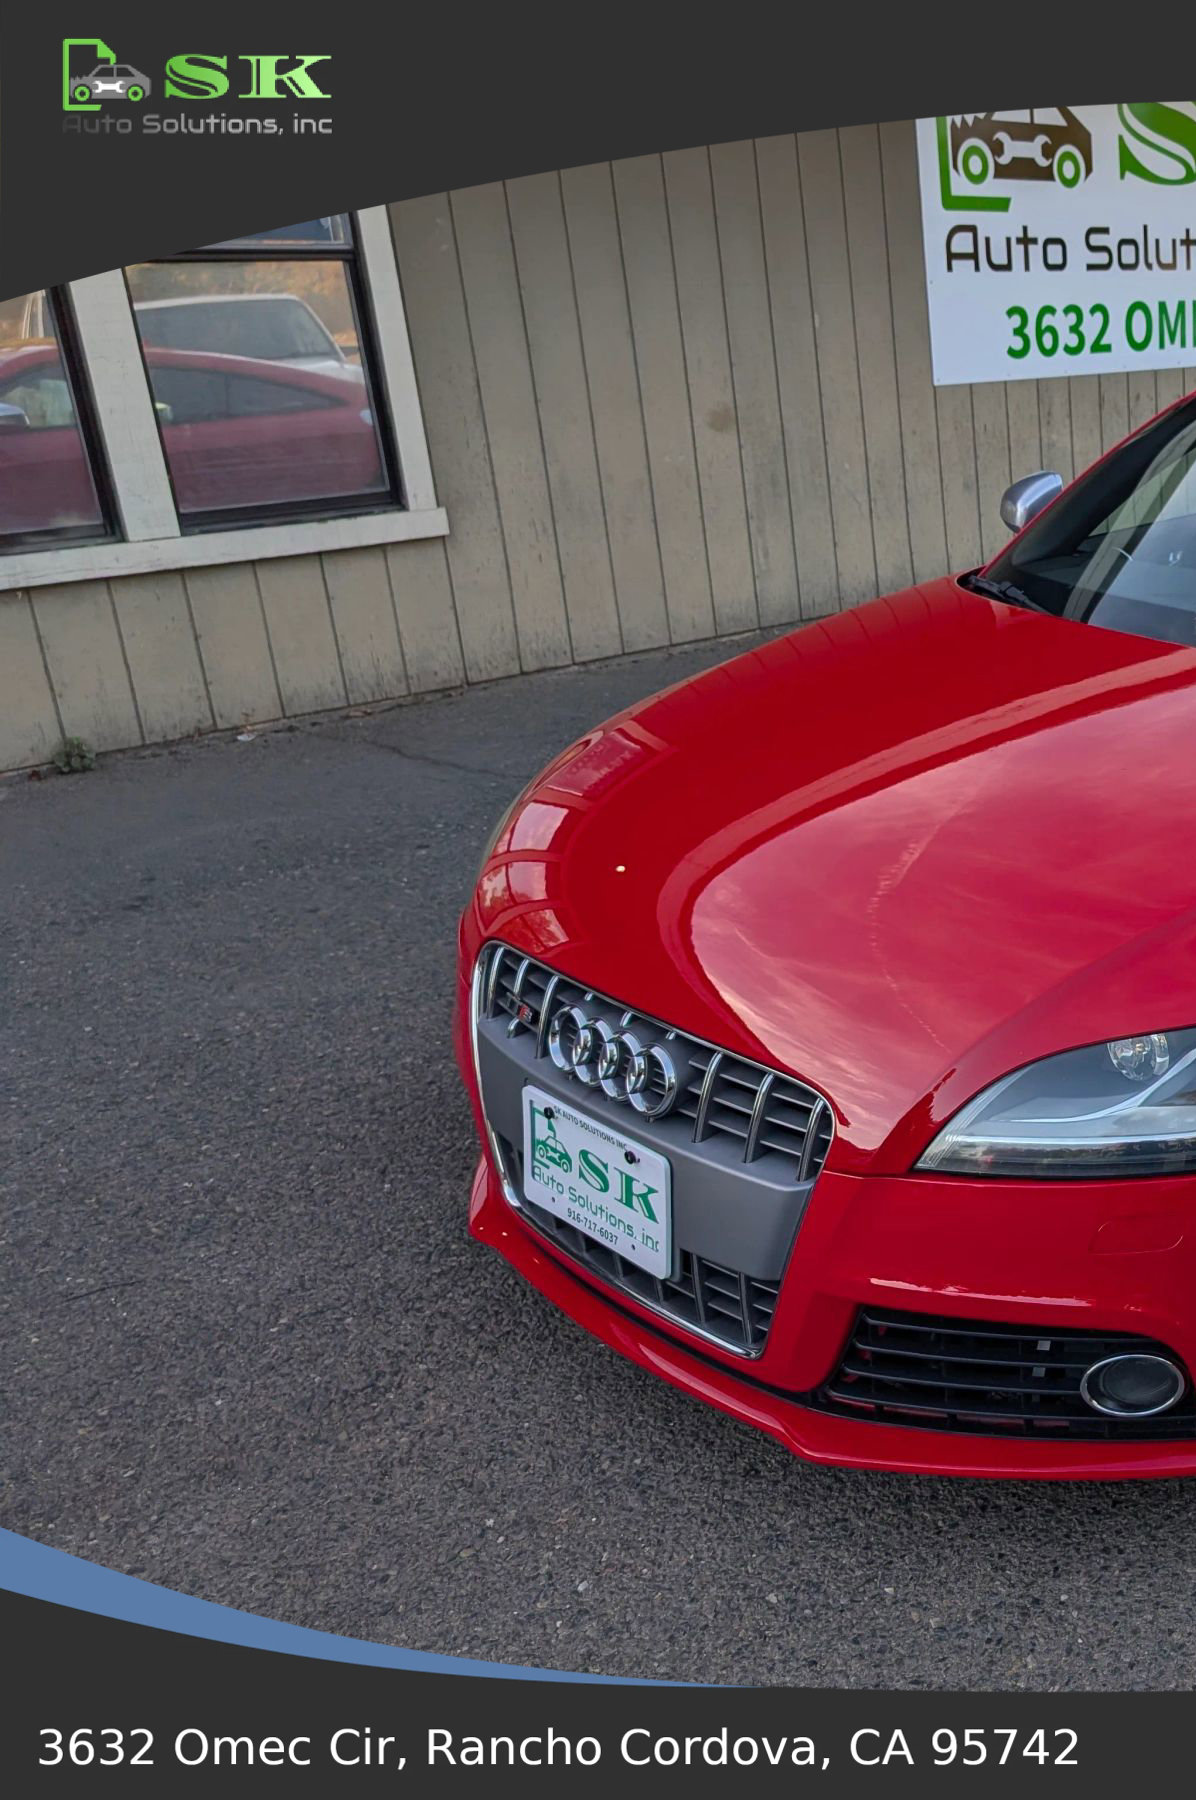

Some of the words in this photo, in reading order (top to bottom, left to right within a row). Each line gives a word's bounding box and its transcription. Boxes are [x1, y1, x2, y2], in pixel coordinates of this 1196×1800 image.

[945, 224, 1068, 273] Auto
[1005, 302, 1112, 360] 3632
[579, 1120, 616, 1147] SOLUTIONS
[533, 1166, 565, 1196] Auto
[578, 1149, 660, 1225] SK
[567, 1207, 619, 1246] 916-717-6037
